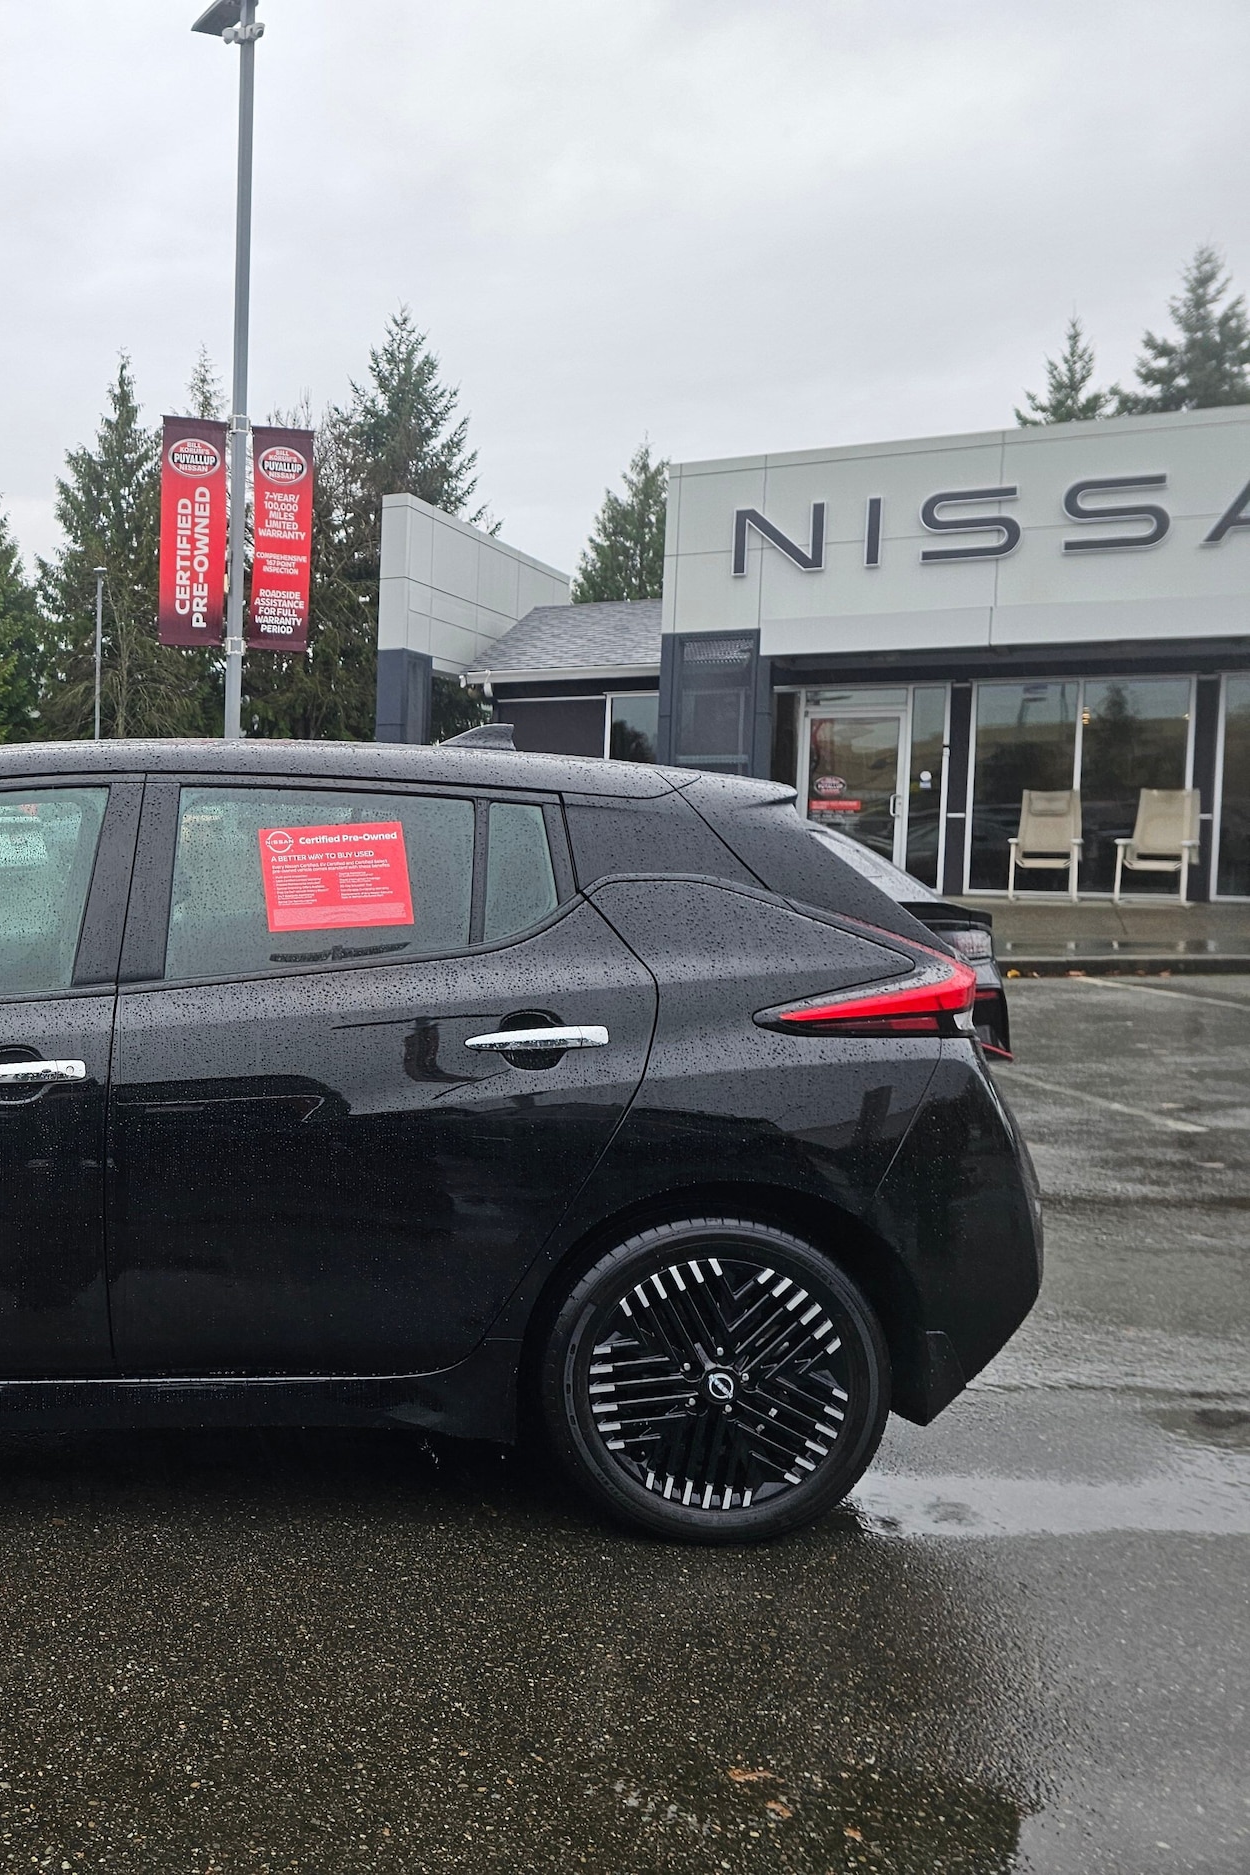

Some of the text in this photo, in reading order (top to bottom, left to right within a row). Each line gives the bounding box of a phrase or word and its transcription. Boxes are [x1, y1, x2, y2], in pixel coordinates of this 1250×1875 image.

[179, 447, 210, 455] KORUM'S
[174, 453, 215, 466] PUYALLUP
[179, 464, 208, 473] NISSAN
[264, 461, 302, 474] PUYALLUP
[269, 471, 295, 480] NISSAN
[264, 491, 300, 503] 7-YEAR/
[264, 500, 298, 512] 100,000
[269, 510, 295, 521] MILES
[265, 519, 298, 530] LIMITED
[258, 527, 306, 541] WARRANTY
[175, 498, 192, 615] CERTIFIED
[192, 486, 210, 628] PRE-OWNED
[256, 552, 307, 563] COMPREHENSIVE
[276, 560, 296, 568] POINT
[262, 565, 299, 575] INSPECTION
[259, 589, 301, 600] ROADSIDE
[254, 597, 305, 609] ASSISTANCE
[258, 606, 297, 617] FOR FULL
[255, 615, 302, 627] WARRANTY
[260, 624, 293, 635] PERIOD
[299, 832, 397, 845] Certified Pre-Owned
